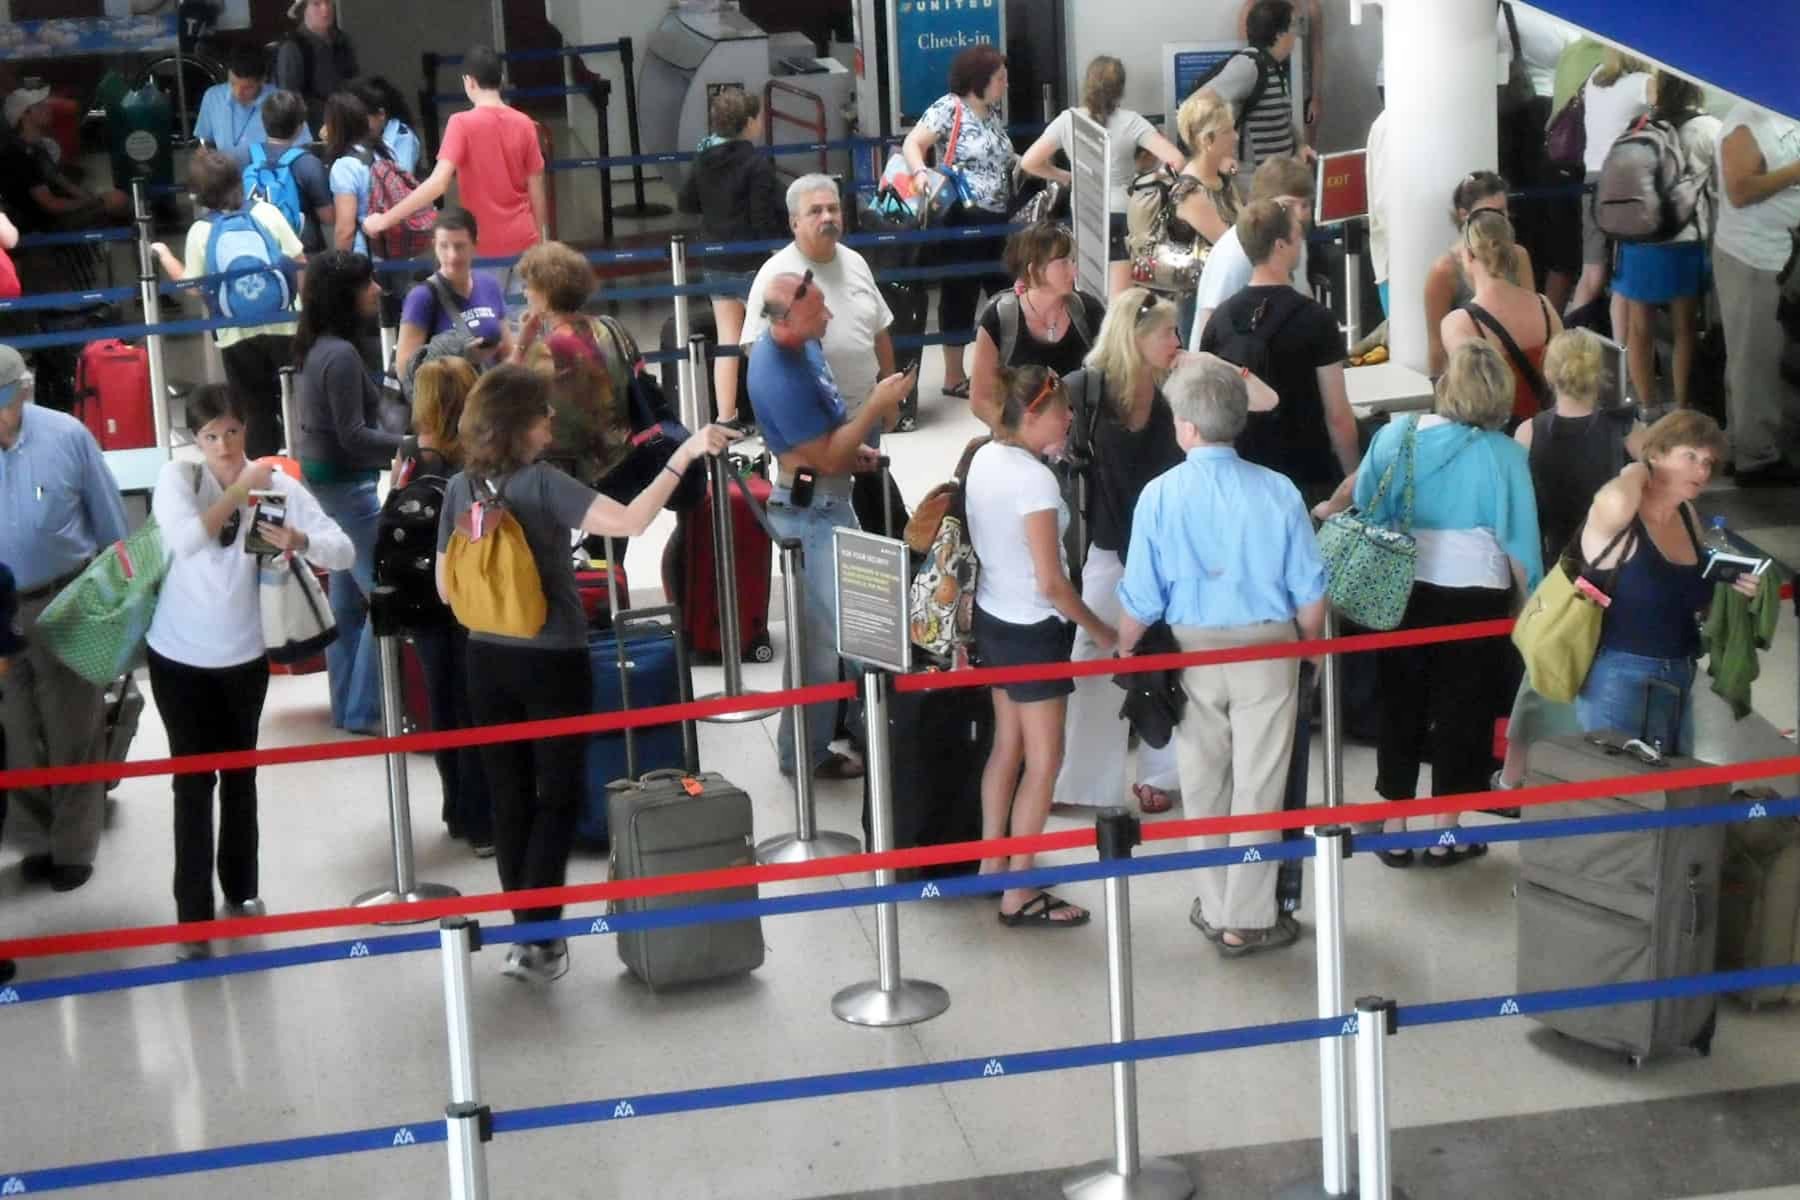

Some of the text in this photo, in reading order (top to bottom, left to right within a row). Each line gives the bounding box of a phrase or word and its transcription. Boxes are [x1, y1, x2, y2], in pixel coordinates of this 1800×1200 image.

[916, 0, 992, 11] UNITED
[918, 30, 991, 49] Check-in
[1327, 174, 1350, 186] EXIT
